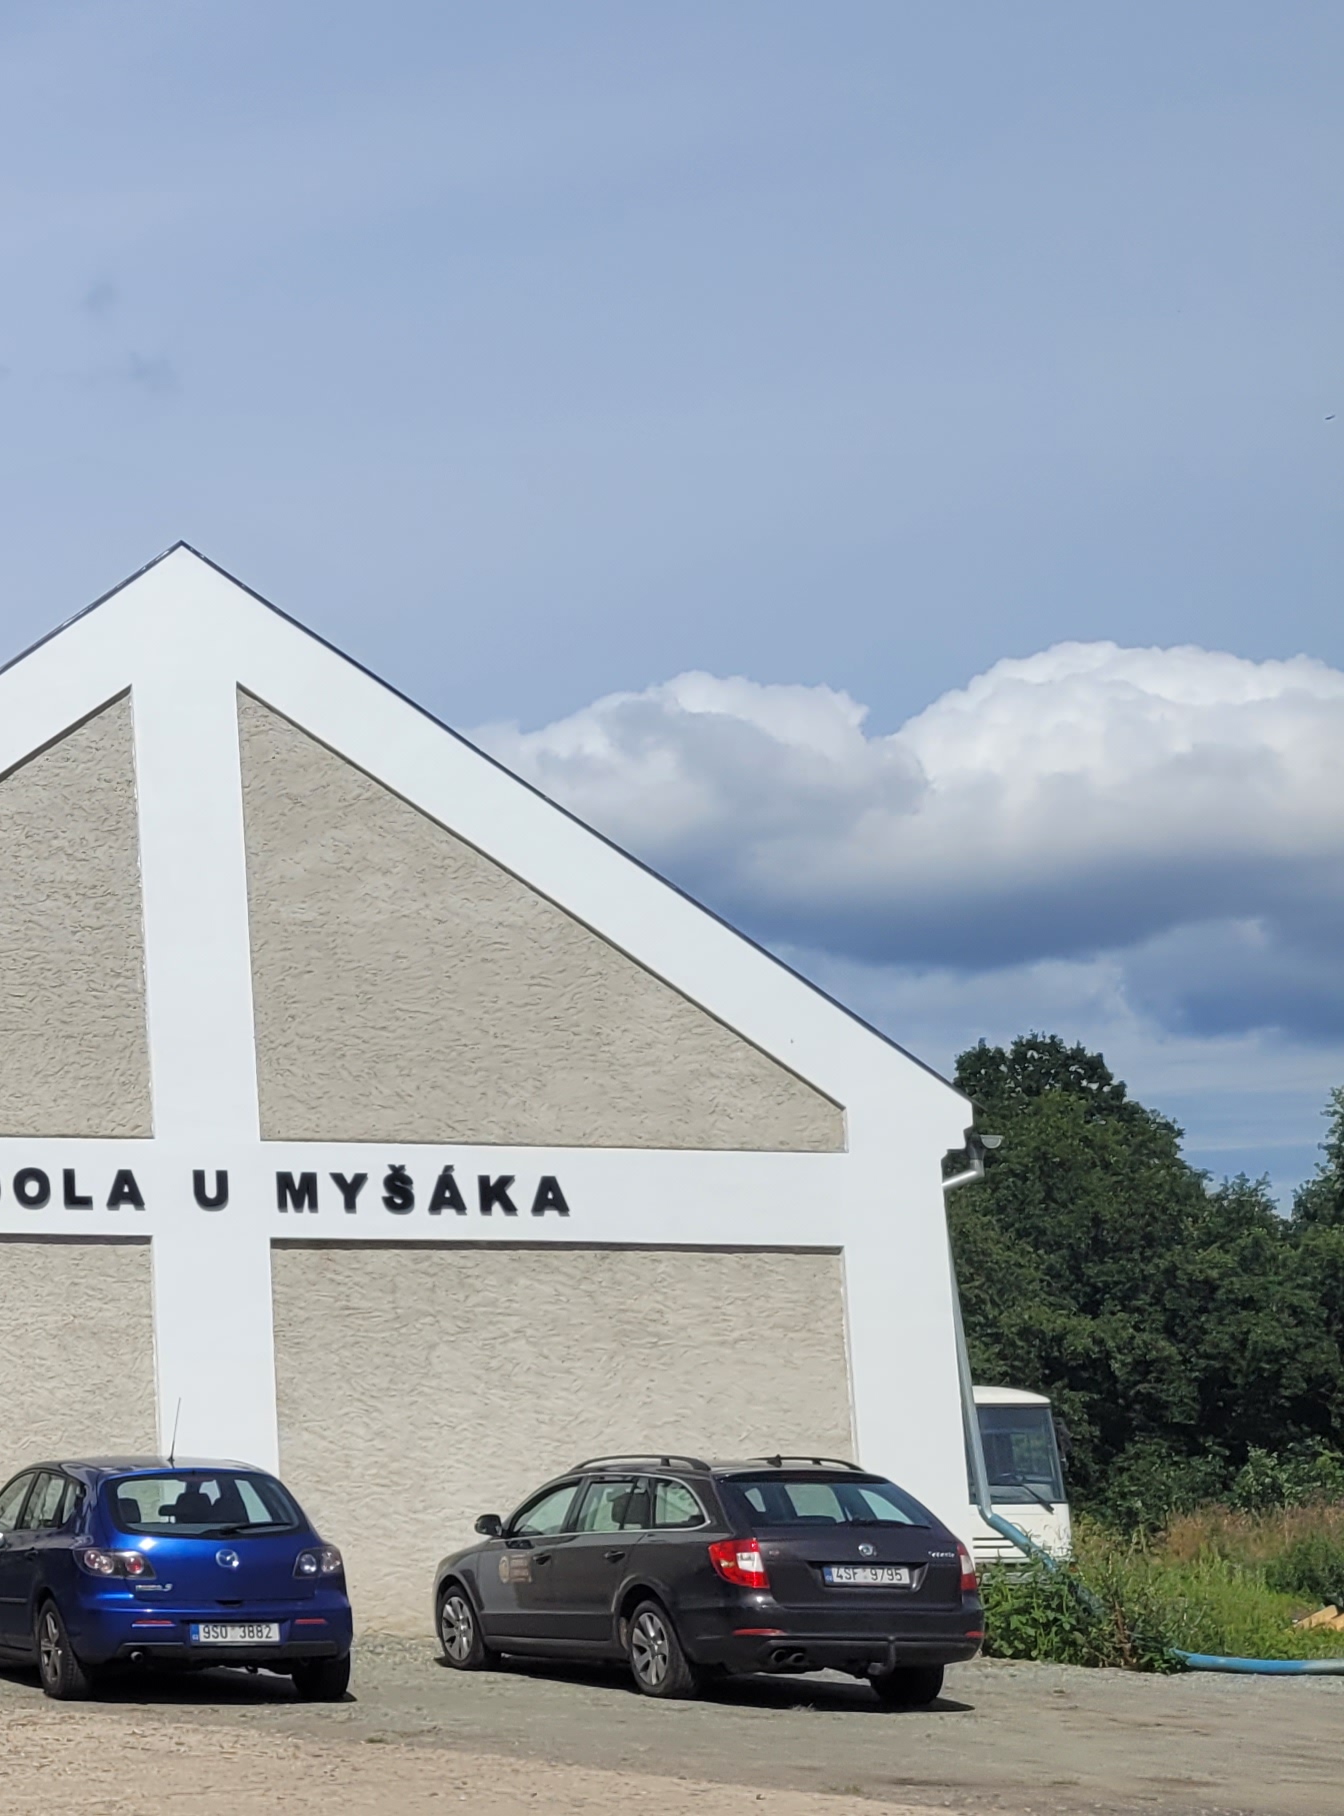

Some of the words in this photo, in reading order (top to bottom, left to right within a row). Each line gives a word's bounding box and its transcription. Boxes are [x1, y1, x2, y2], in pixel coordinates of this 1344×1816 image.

[192, 1169, 229, 1212] U
[275, 1164, 571, 1217] MYŠÁKA
[835, 1567, 859, 1581] 4SF
[869, 1568, 903, 1582] 9795
[238, 1625, 273, 1640] 3882
